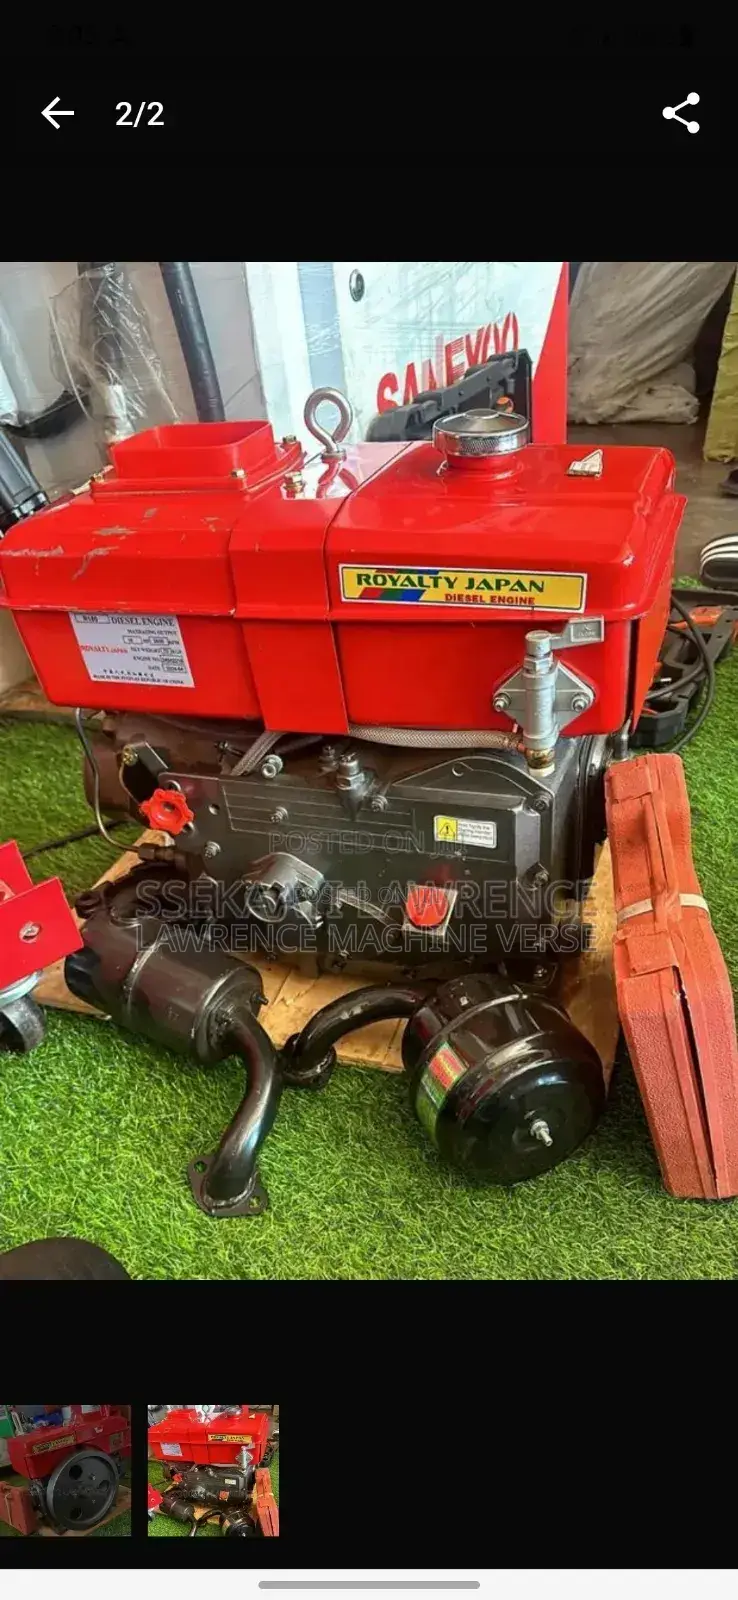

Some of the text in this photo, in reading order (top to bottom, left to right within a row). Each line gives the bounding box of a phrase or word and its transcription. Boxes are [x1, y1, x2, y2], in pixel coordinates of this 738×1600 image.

[115, 101, 164, 128] 2/2
[356, 572, 546, 593] ROYALTY JAPAN
[490, 595, 536, 606] ENGINE
[111, 616, 141, 626] DIESEL
[143, 618, 175, 627] ENGINE
